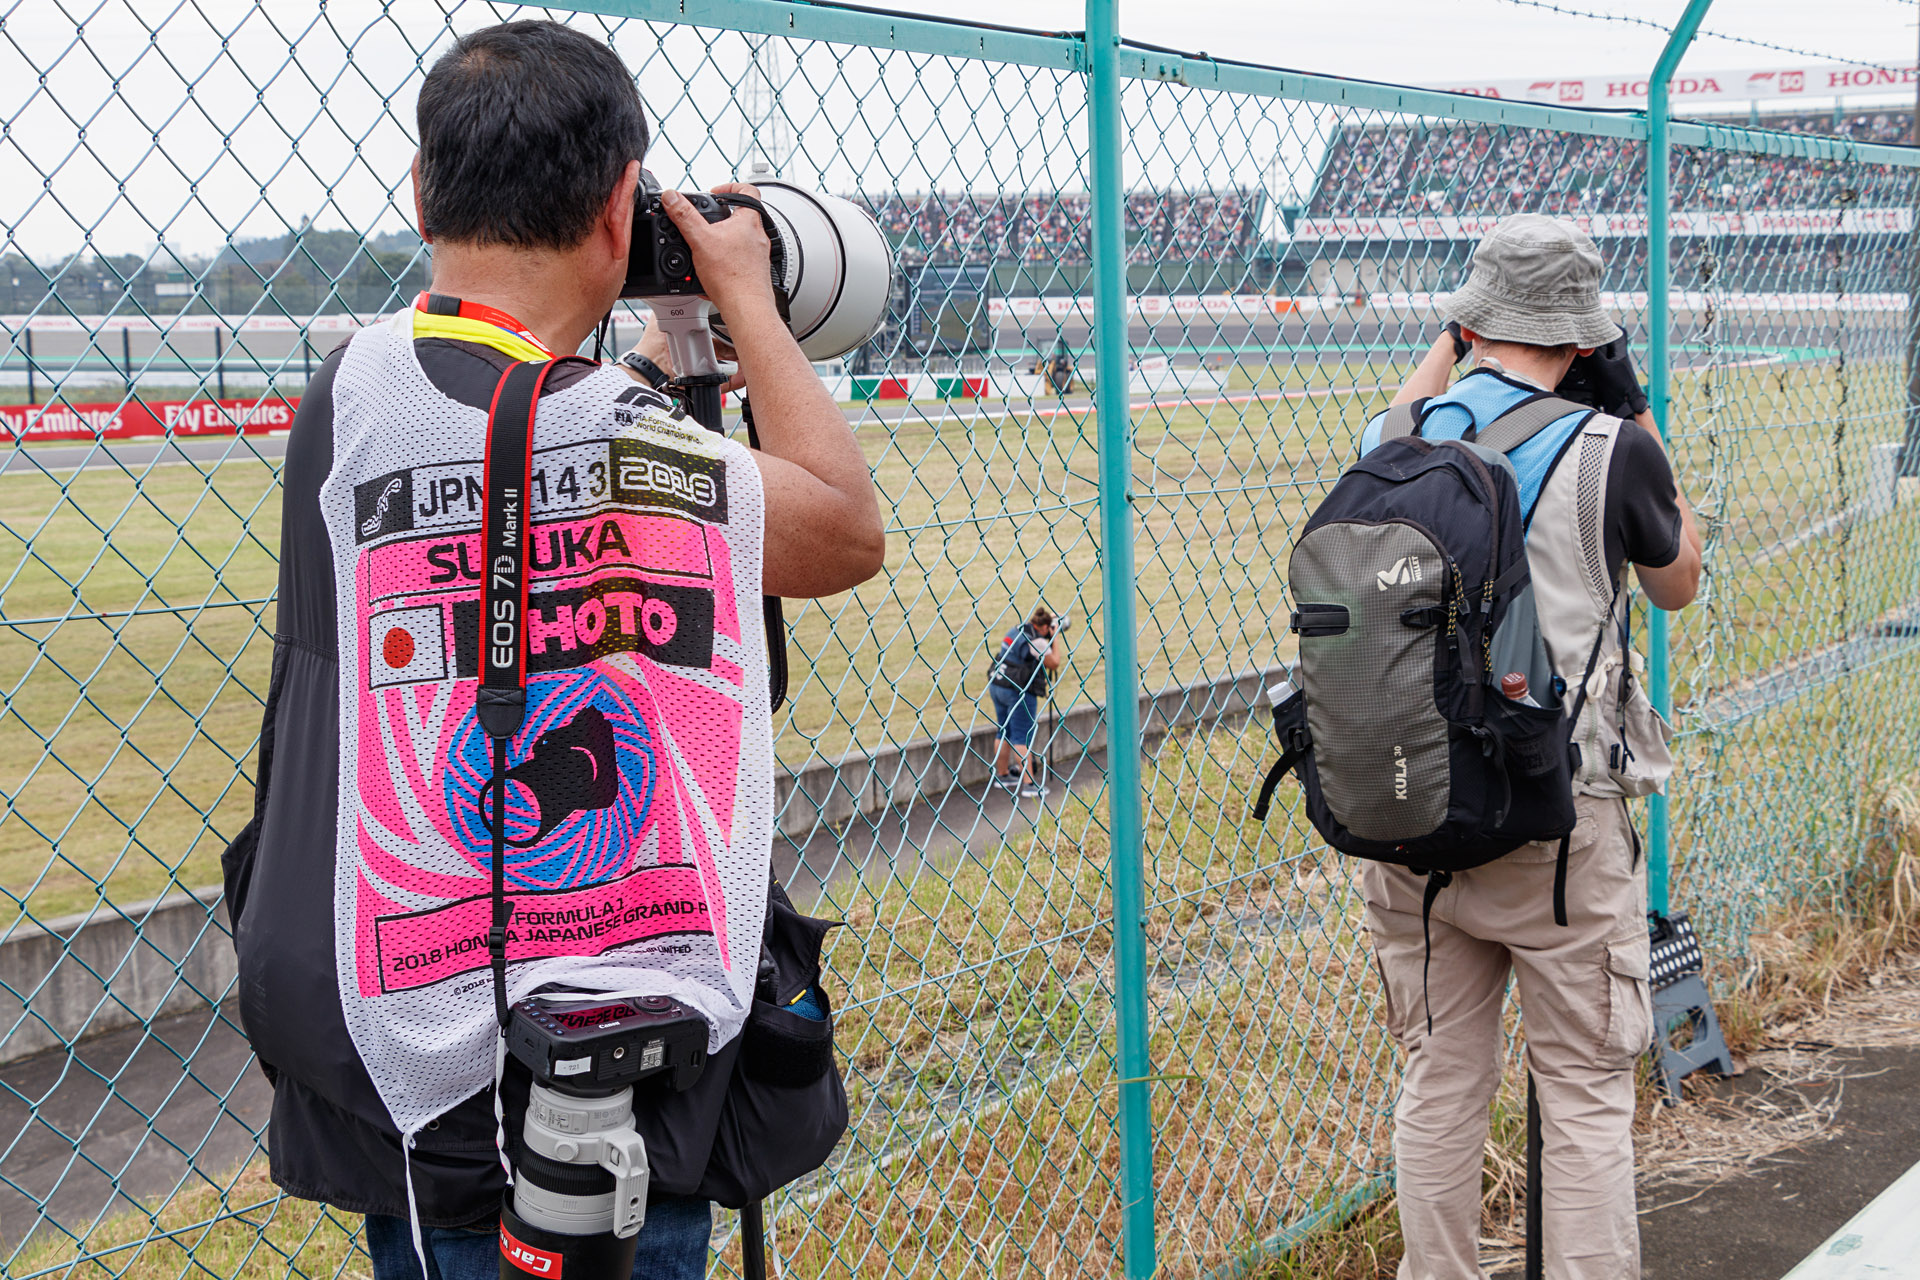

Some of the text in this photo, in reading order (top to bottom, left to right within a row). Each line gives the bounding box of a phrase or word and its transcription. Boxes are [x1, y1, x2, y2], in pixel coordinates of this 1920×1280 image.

[1606, 78, 1721, 97] HODA
[1828, 67, 1917, 87] HOND
[1306, 222, 1386, 235] HONDA
[670, 308, 684, 317] 600
[0, 408, 123, 434] ly Emirates
[165, 402, 289, 432] Fly Emirates
[636, 421, 656, 433] World
[620, 456, 716, 507] 2018
[502, 501, 518, 548] Mark
[426, 520, 632, 584] SUUKA
[492, 554, 516, 590] 7D
[491, 599, 515, 669] EOS
[528, 591, 677, 655] HOTO
[1393, 745, 1408, 800] KULA 30
[515, 902, 615, 926] FORMULA
[391, 949, 443, 972] 2018
[445, 929, 520, 959] HONA
[524, 913, 622, 943] JAPANESE
[623, 900, 698, 925] GRAND
[599, 1021, 621, 1029] Canon
[510, 1246, 552, 1273] Car
